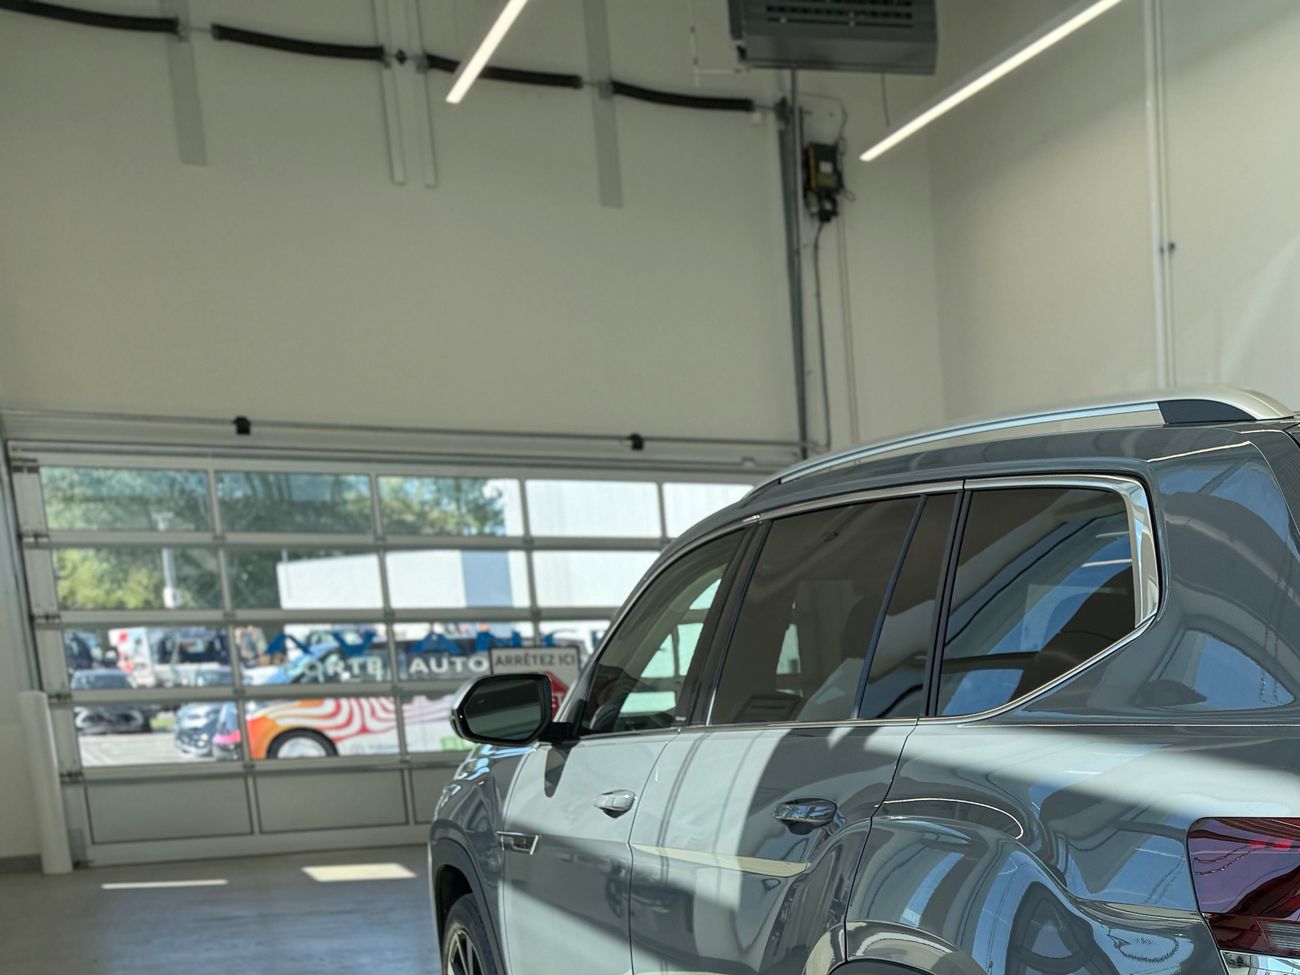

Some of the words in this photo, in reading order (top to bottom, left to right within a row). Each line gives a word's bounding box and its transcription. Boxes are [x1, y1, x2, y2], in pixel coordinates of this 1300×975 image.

[408, 656, 490, 674] AUTO
[495, 652, 556, 667] ARRÊTEZ
[558, 653, 576, 665] ICI
